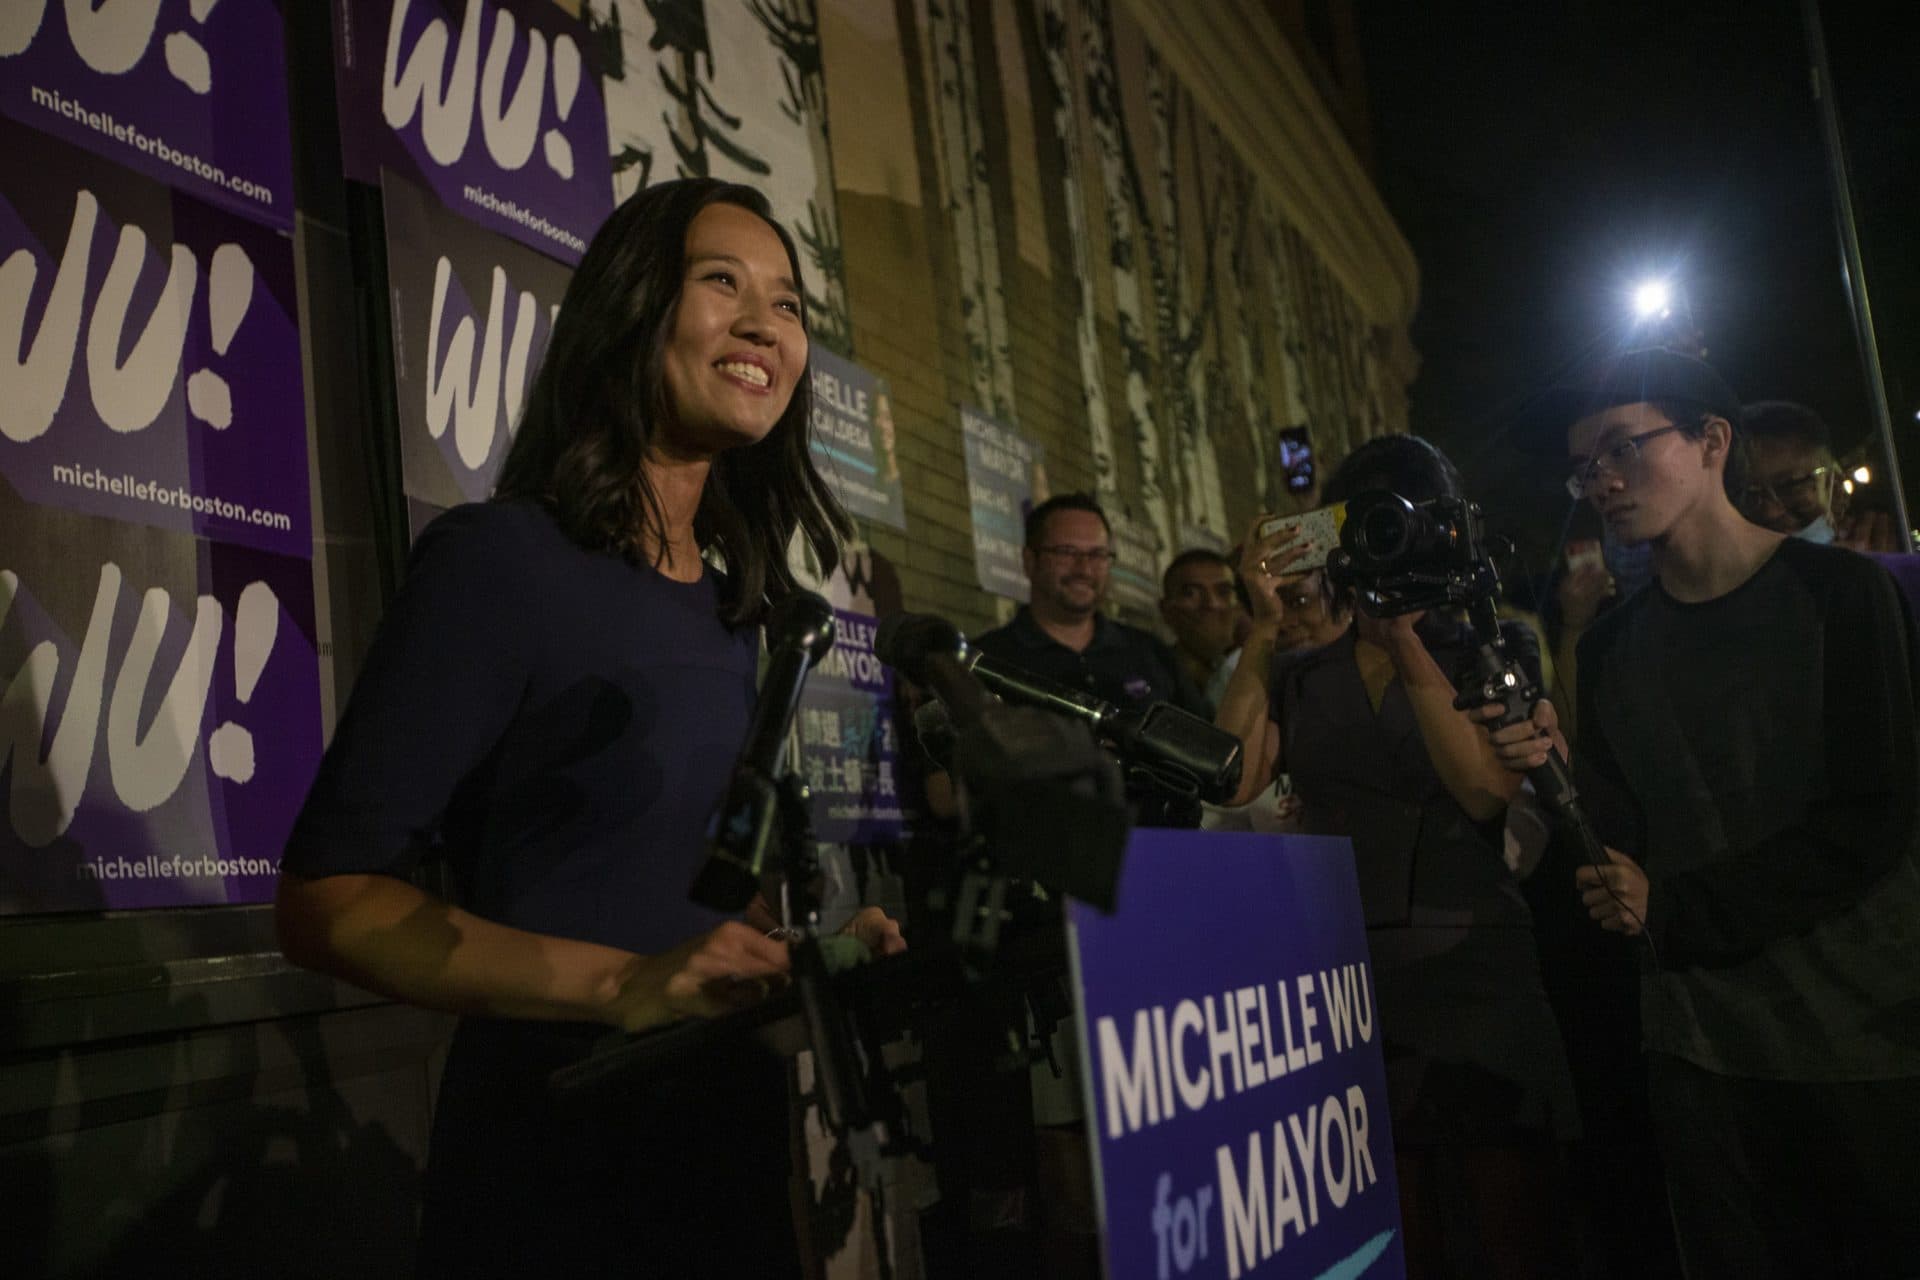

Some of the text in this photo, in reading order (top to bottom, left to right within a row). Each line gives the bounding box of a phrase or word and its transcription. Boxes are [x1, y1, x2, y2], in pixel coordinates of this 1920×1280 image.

[31, 84, 273, 205] michelleforboston.com
[382, 0, 581, 180] WU!
[463, 184, 587, 255] michelleforboston
[53, 462, 291, 532] michelleforboston.com
[1097, 961, 1373, 1140] MICHELLE WU
[1151, 1084, 1378, 1280] for MAYOR
